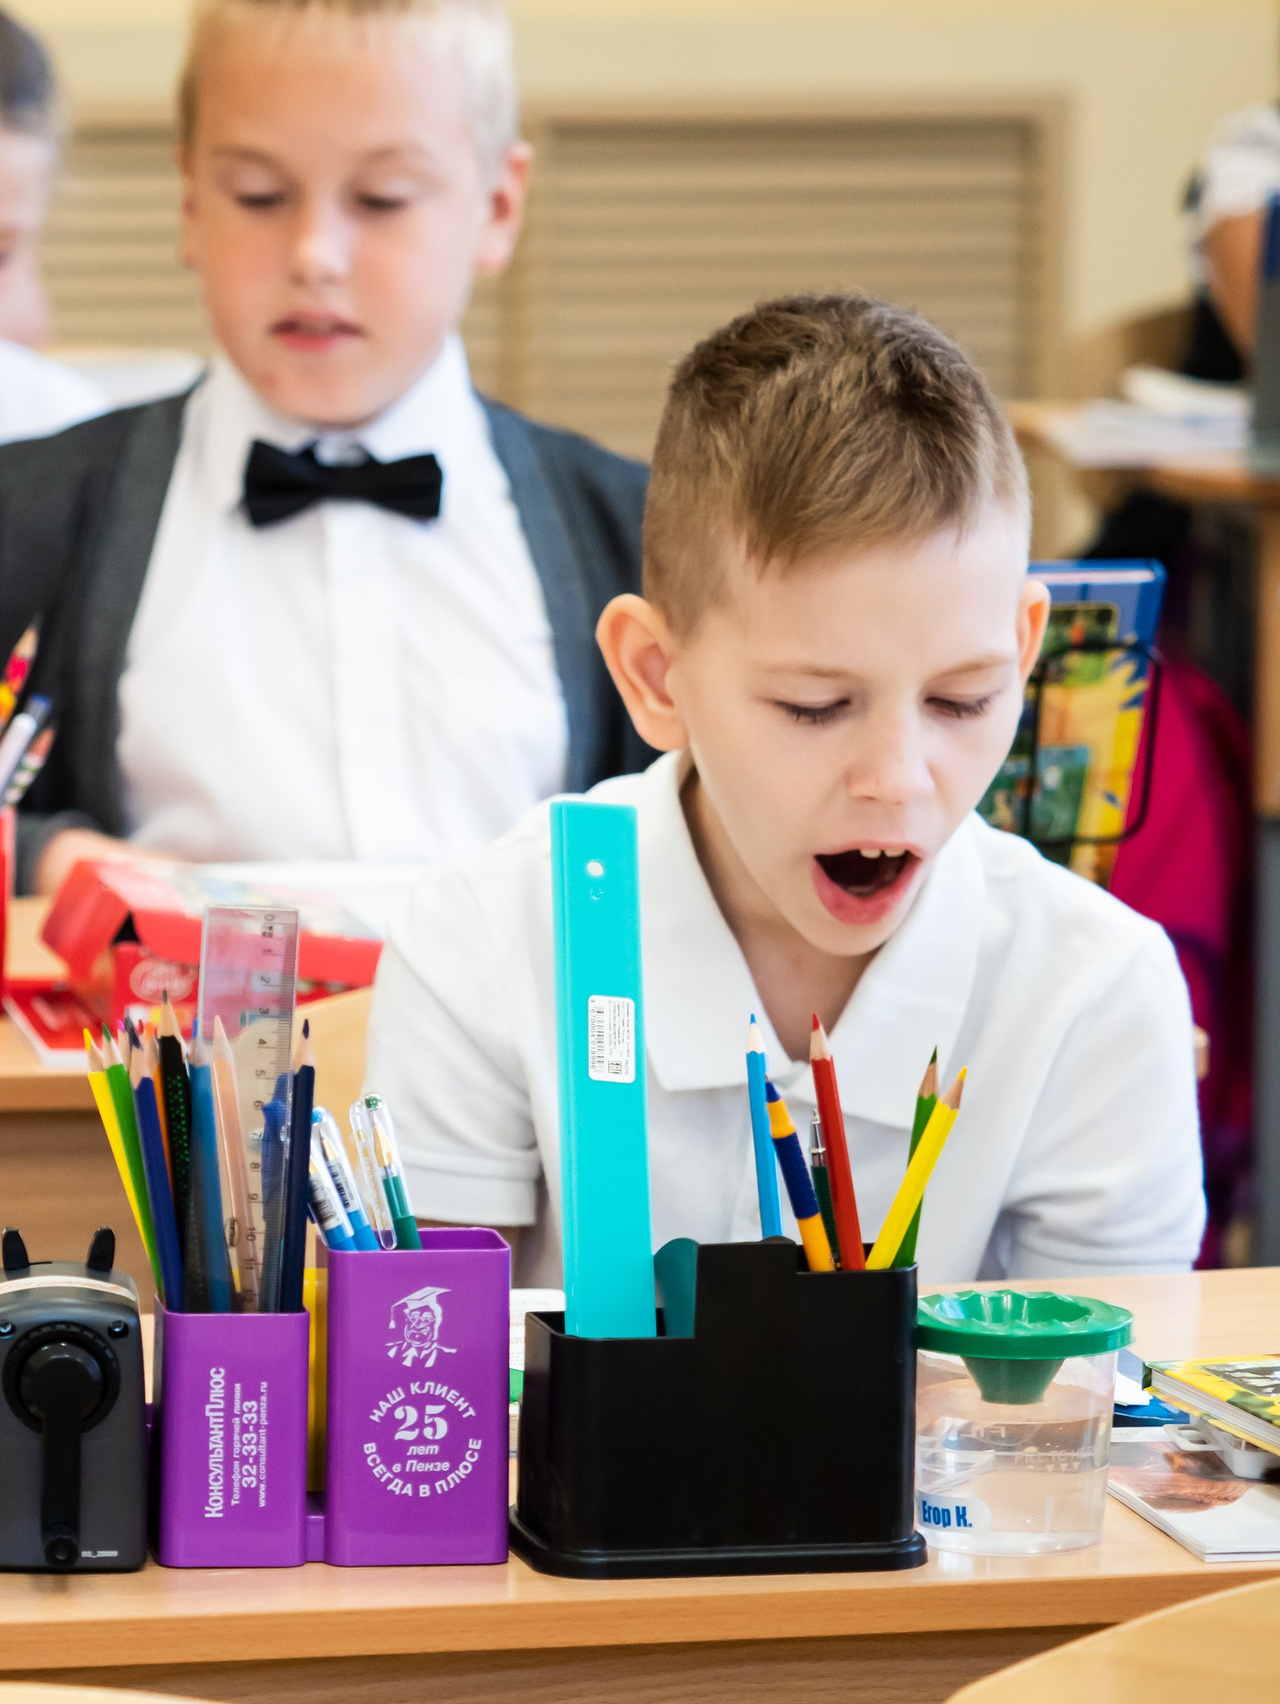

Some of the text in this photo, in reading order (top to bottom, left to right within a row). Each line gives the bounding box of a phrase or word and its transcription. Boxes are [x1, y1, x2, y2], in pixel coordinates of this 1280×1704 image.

[369, 1381, 476, 1423] НАШ КЛИЕНТ
[232, 1417, 241, 1458] горячей
[394, 1405, 448, 1441] 25
[242, 1400, 258, 1488] 32-33-33
[258, 1381, 268, 1507] www.consultant-penza.ru
[406, 1445, 439, 1456] лет
[231, 1461, 241, 1506] Телефон
[363, 1438, 482, 1497] ВСЕГДА В ПЛЮСЕ
[392, 1460, 450, 1473] в Пензе
[922, 1501, 973, 1528] Егор К.
